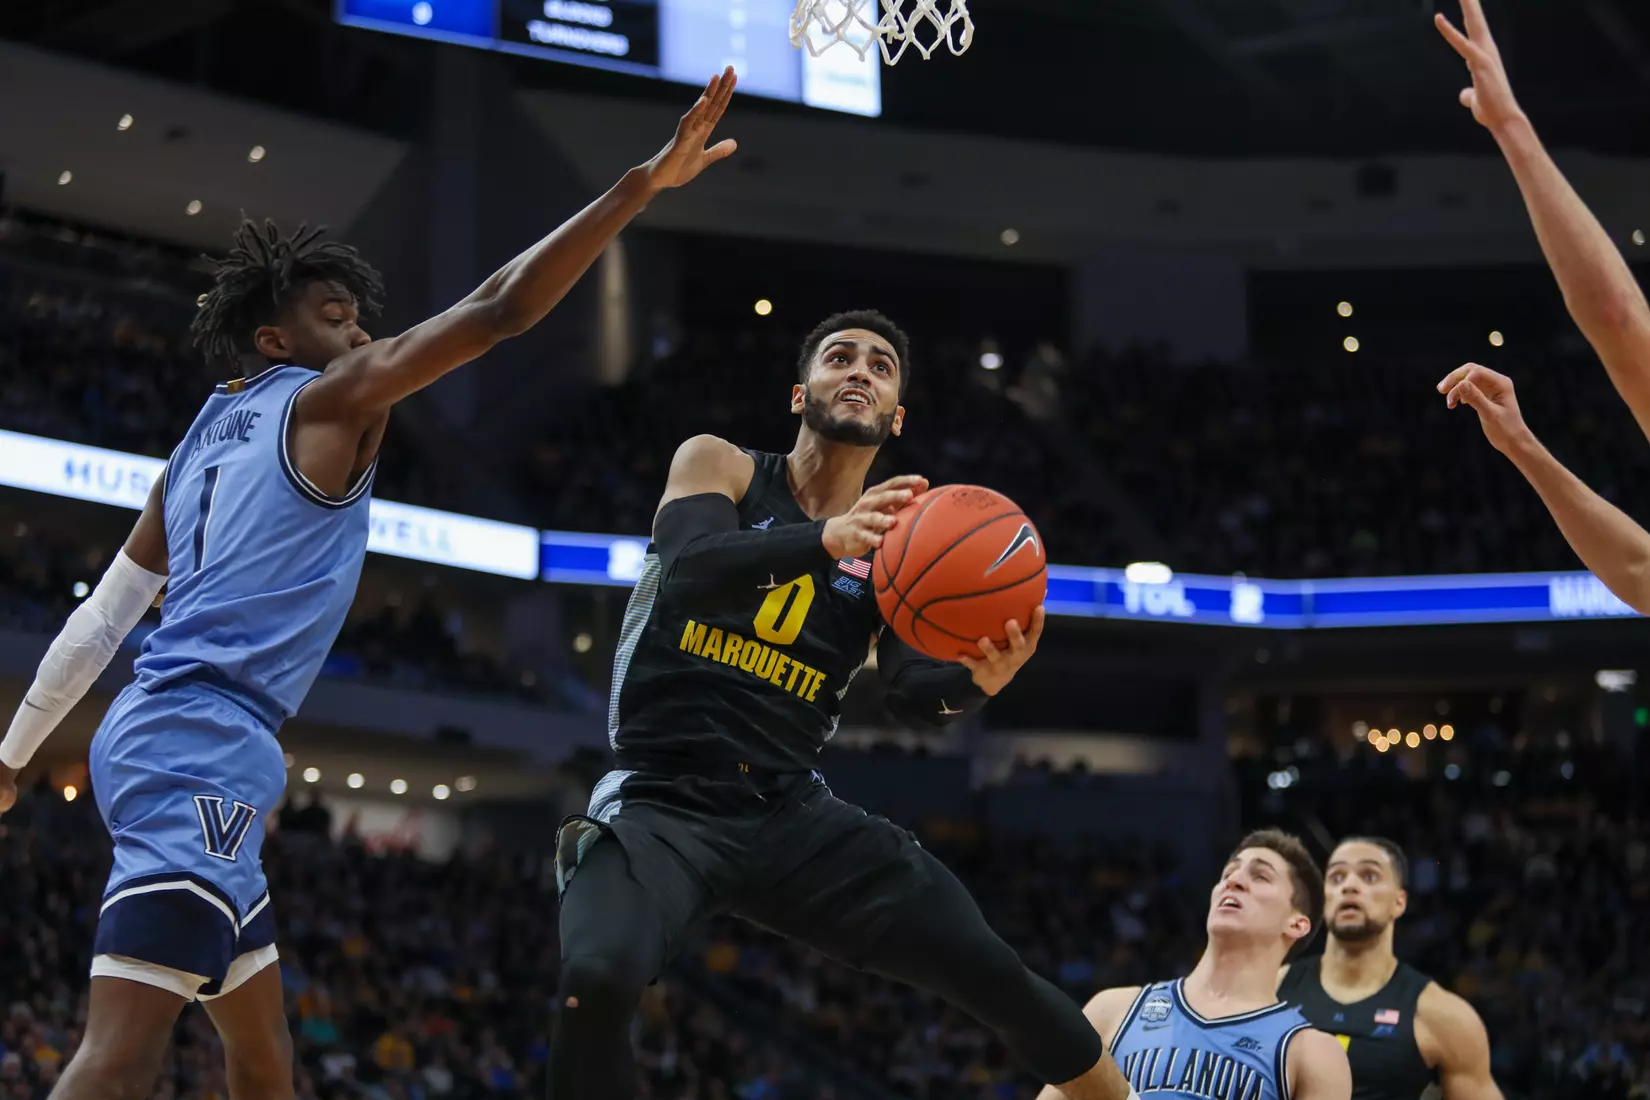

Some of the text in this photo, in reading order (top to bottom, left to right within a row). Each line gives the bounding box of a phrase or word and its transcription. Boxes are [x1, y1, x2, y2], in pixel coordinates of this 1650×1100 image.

[190, 409, 262, 459] ANTOINE
[192, 465, 222, 575] 1
[753, 573, 815, 645] 0
[679, 619, 827, 703] MARQUETTE
[193, 795, 257, 861] V
[1123, 1046, 1265, 1100] VILLANOVA
